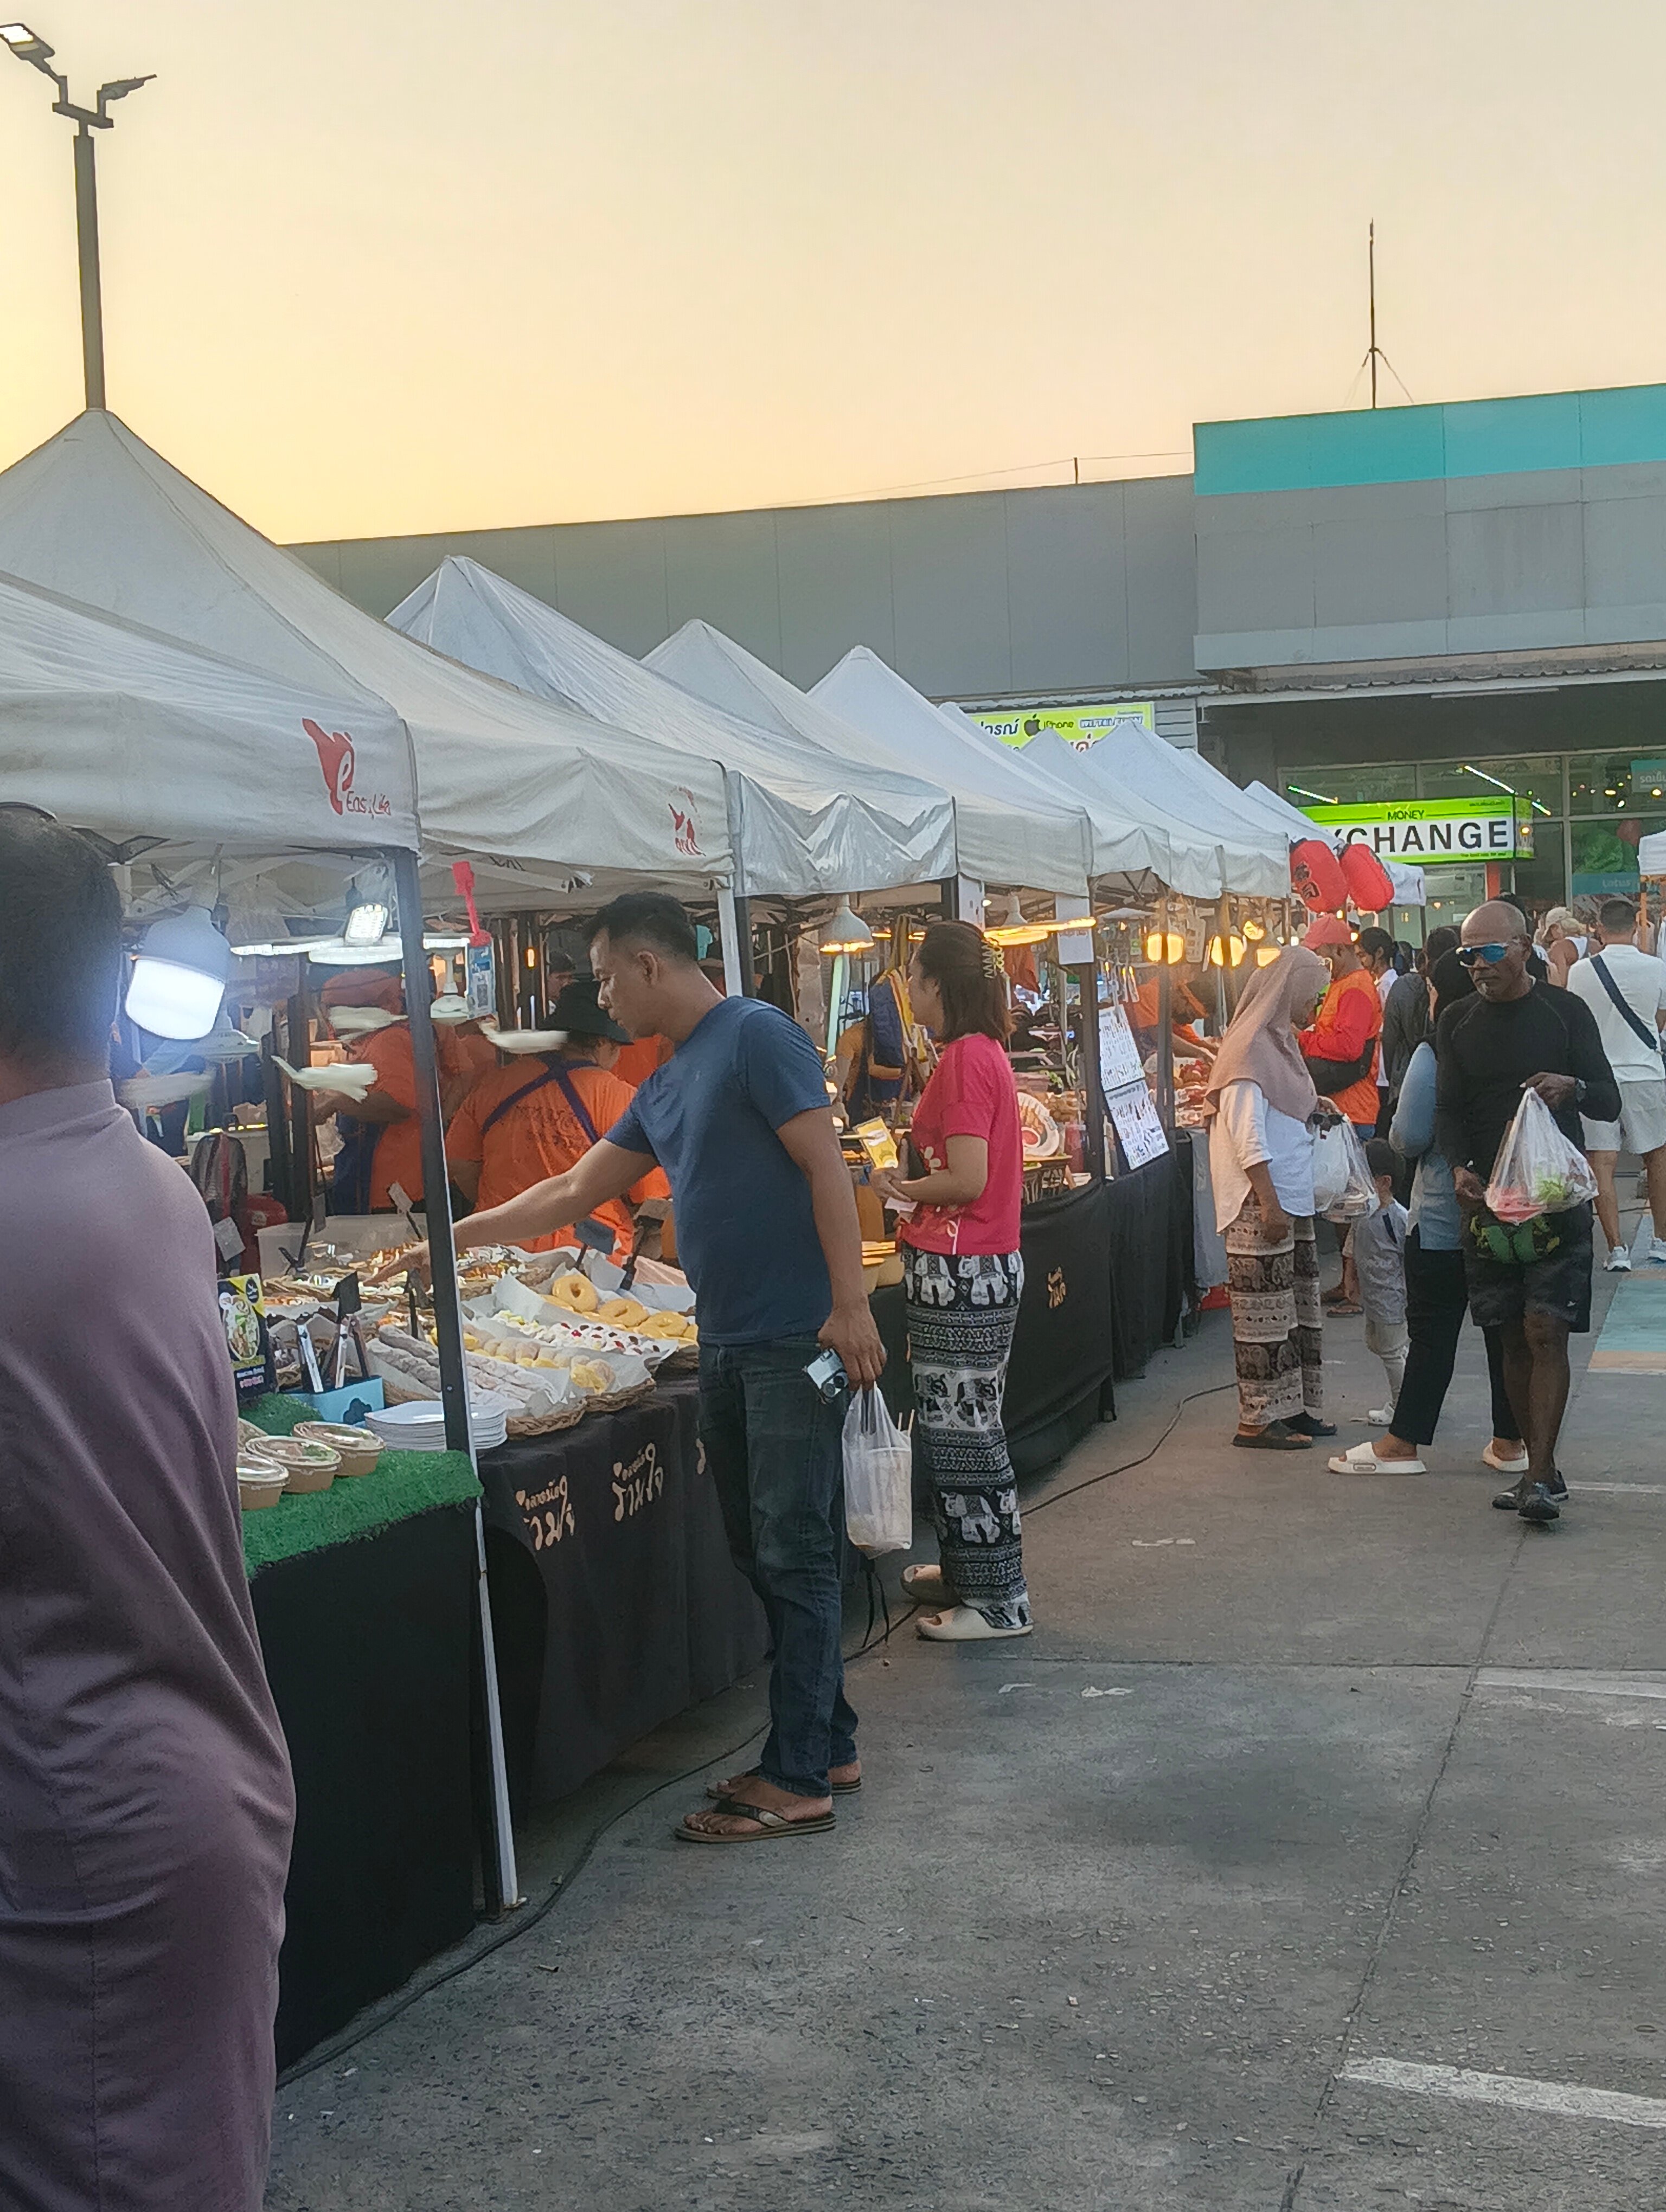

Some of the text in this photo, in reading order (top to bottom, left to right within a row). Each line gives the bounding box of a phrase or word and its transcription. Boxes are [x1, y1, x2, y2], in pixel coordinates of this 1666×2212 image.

[981, 718, 1020, 735] กรณ์
[1387, 809, 1425, 820] MONEY
[1335, 820, 1508, 853] CHANGE
